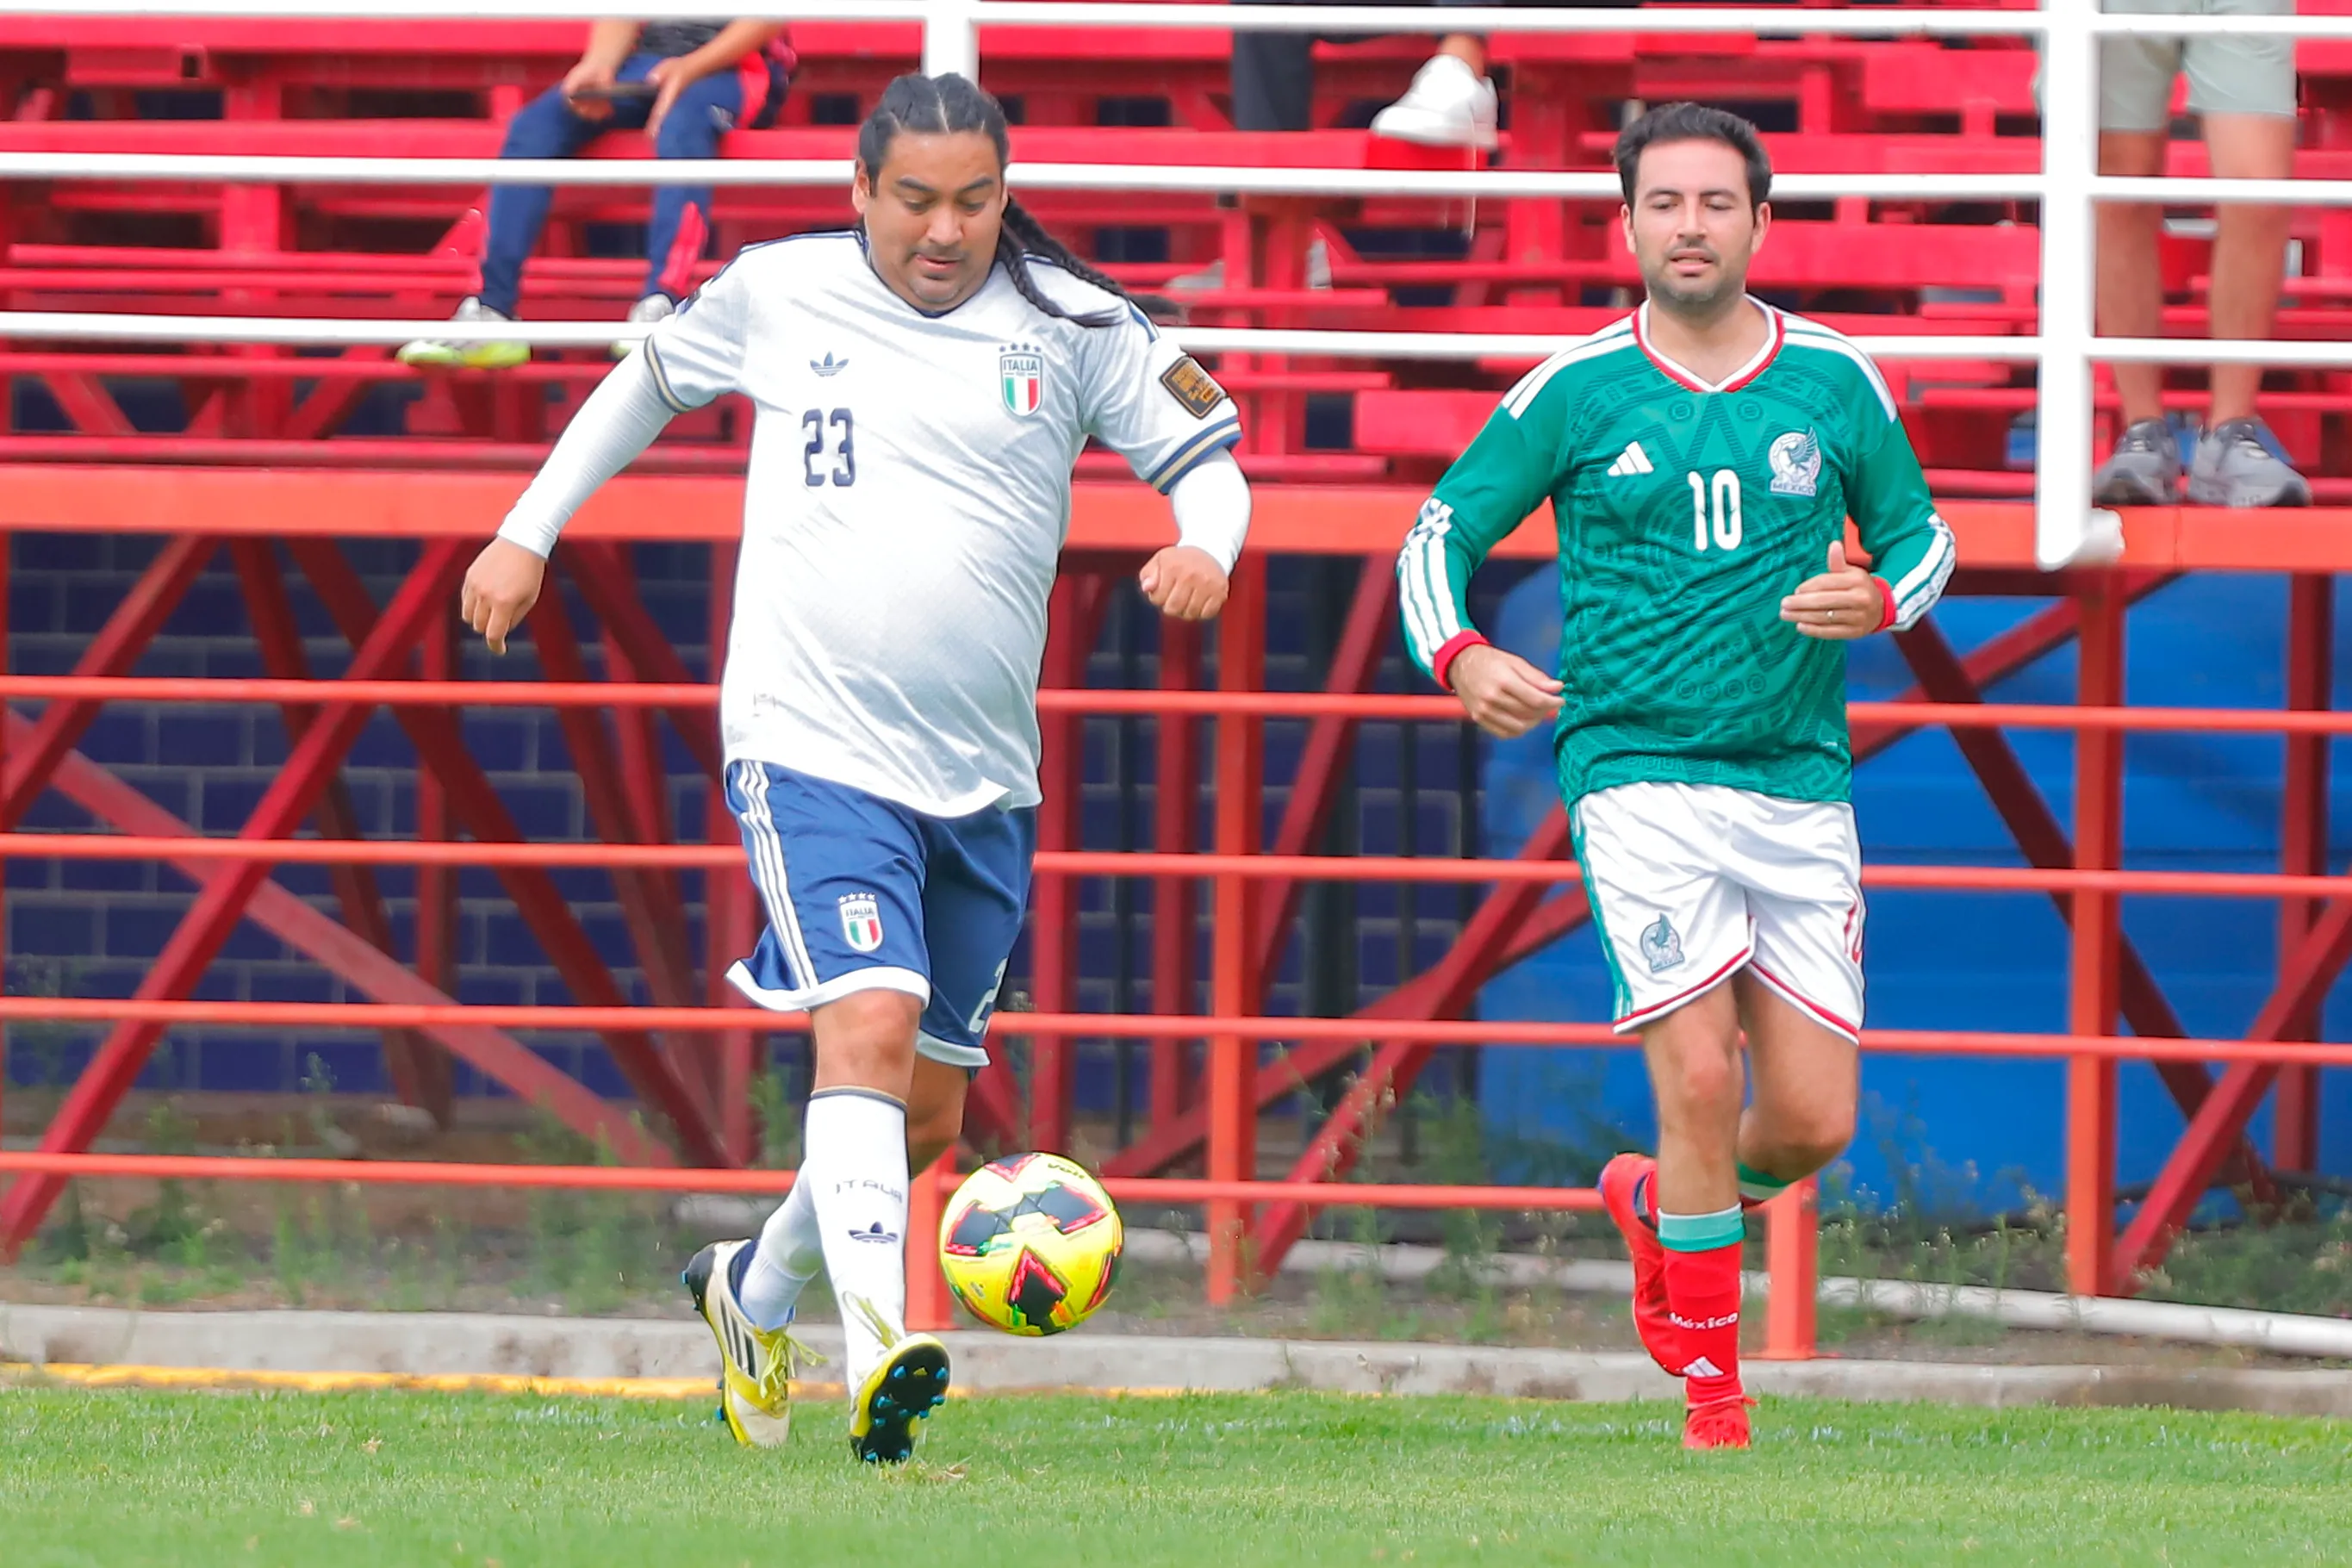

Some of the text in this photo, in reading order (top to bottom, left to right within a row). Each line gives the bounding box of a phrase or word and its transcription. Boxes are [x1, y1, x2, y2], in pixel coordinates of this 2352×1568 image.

[1003, 359, 1038, 370] ITALIA
[802, 408, 856, 488] 23
[1687, 469, 1742, 551] 10
